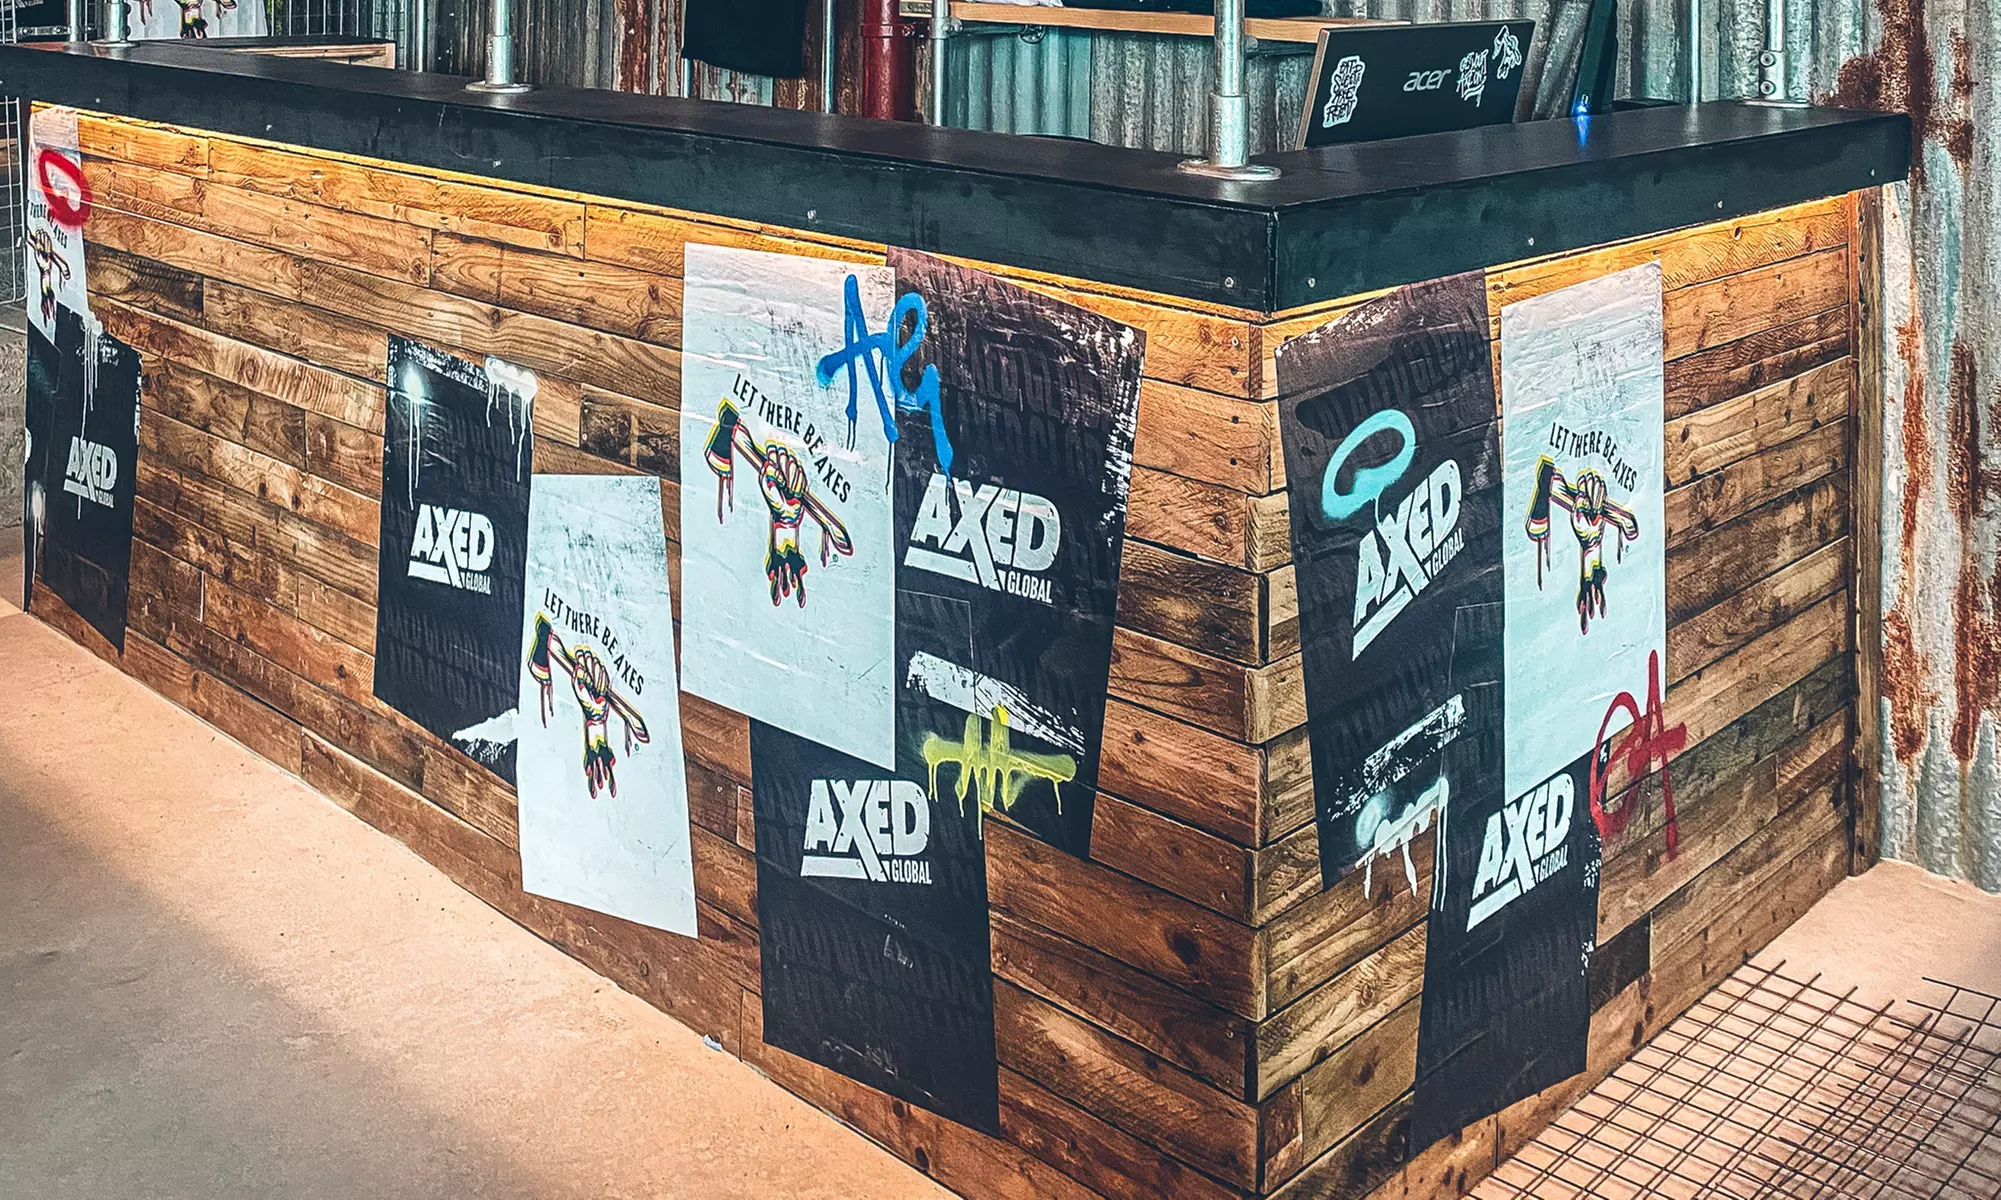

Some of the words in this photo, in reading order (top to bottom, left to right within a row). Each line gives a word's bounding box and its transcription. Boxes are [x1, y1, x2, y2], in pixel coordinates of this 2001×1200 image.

[1403, 69, 1451, 92] acer
[732, 373, 758, 408] LET
[758, 394, 803, 435] THERE
[803, 422, 824, 456] BE
[1549, 421, 1570, 452] LET
[1568, 430, 1603, 458] THERE
[1602, 435, 1618, 465] BE
[1612, 457, 1638, 493] AXES
[65, 435, 118, 503] AXED
[813, 455, 851, 503] AXES
[410, 503, 494, 589] AXED
[910, 473, 1061, 592] AXED
[1353, 459, 1461, 629] AXED
[1432, 527, 1465, 577] GLOBAL
[465, 571, 491, 595] GLOBAL
[1007, 570, 1052, 604] GLOBAL
[544, 587, 564, 618] LET
[564, 605, 600, 638] THERE
[601, 625, 618, 656] BE
[613, 653, 644, 696] AXES
[803, 779, 930, 882] AXED
[1472, 772, 1575, 901] AXED
[889, 858, 932, 884] GLOBAL
[1539, 844, 1568, 882] GLOBAL
